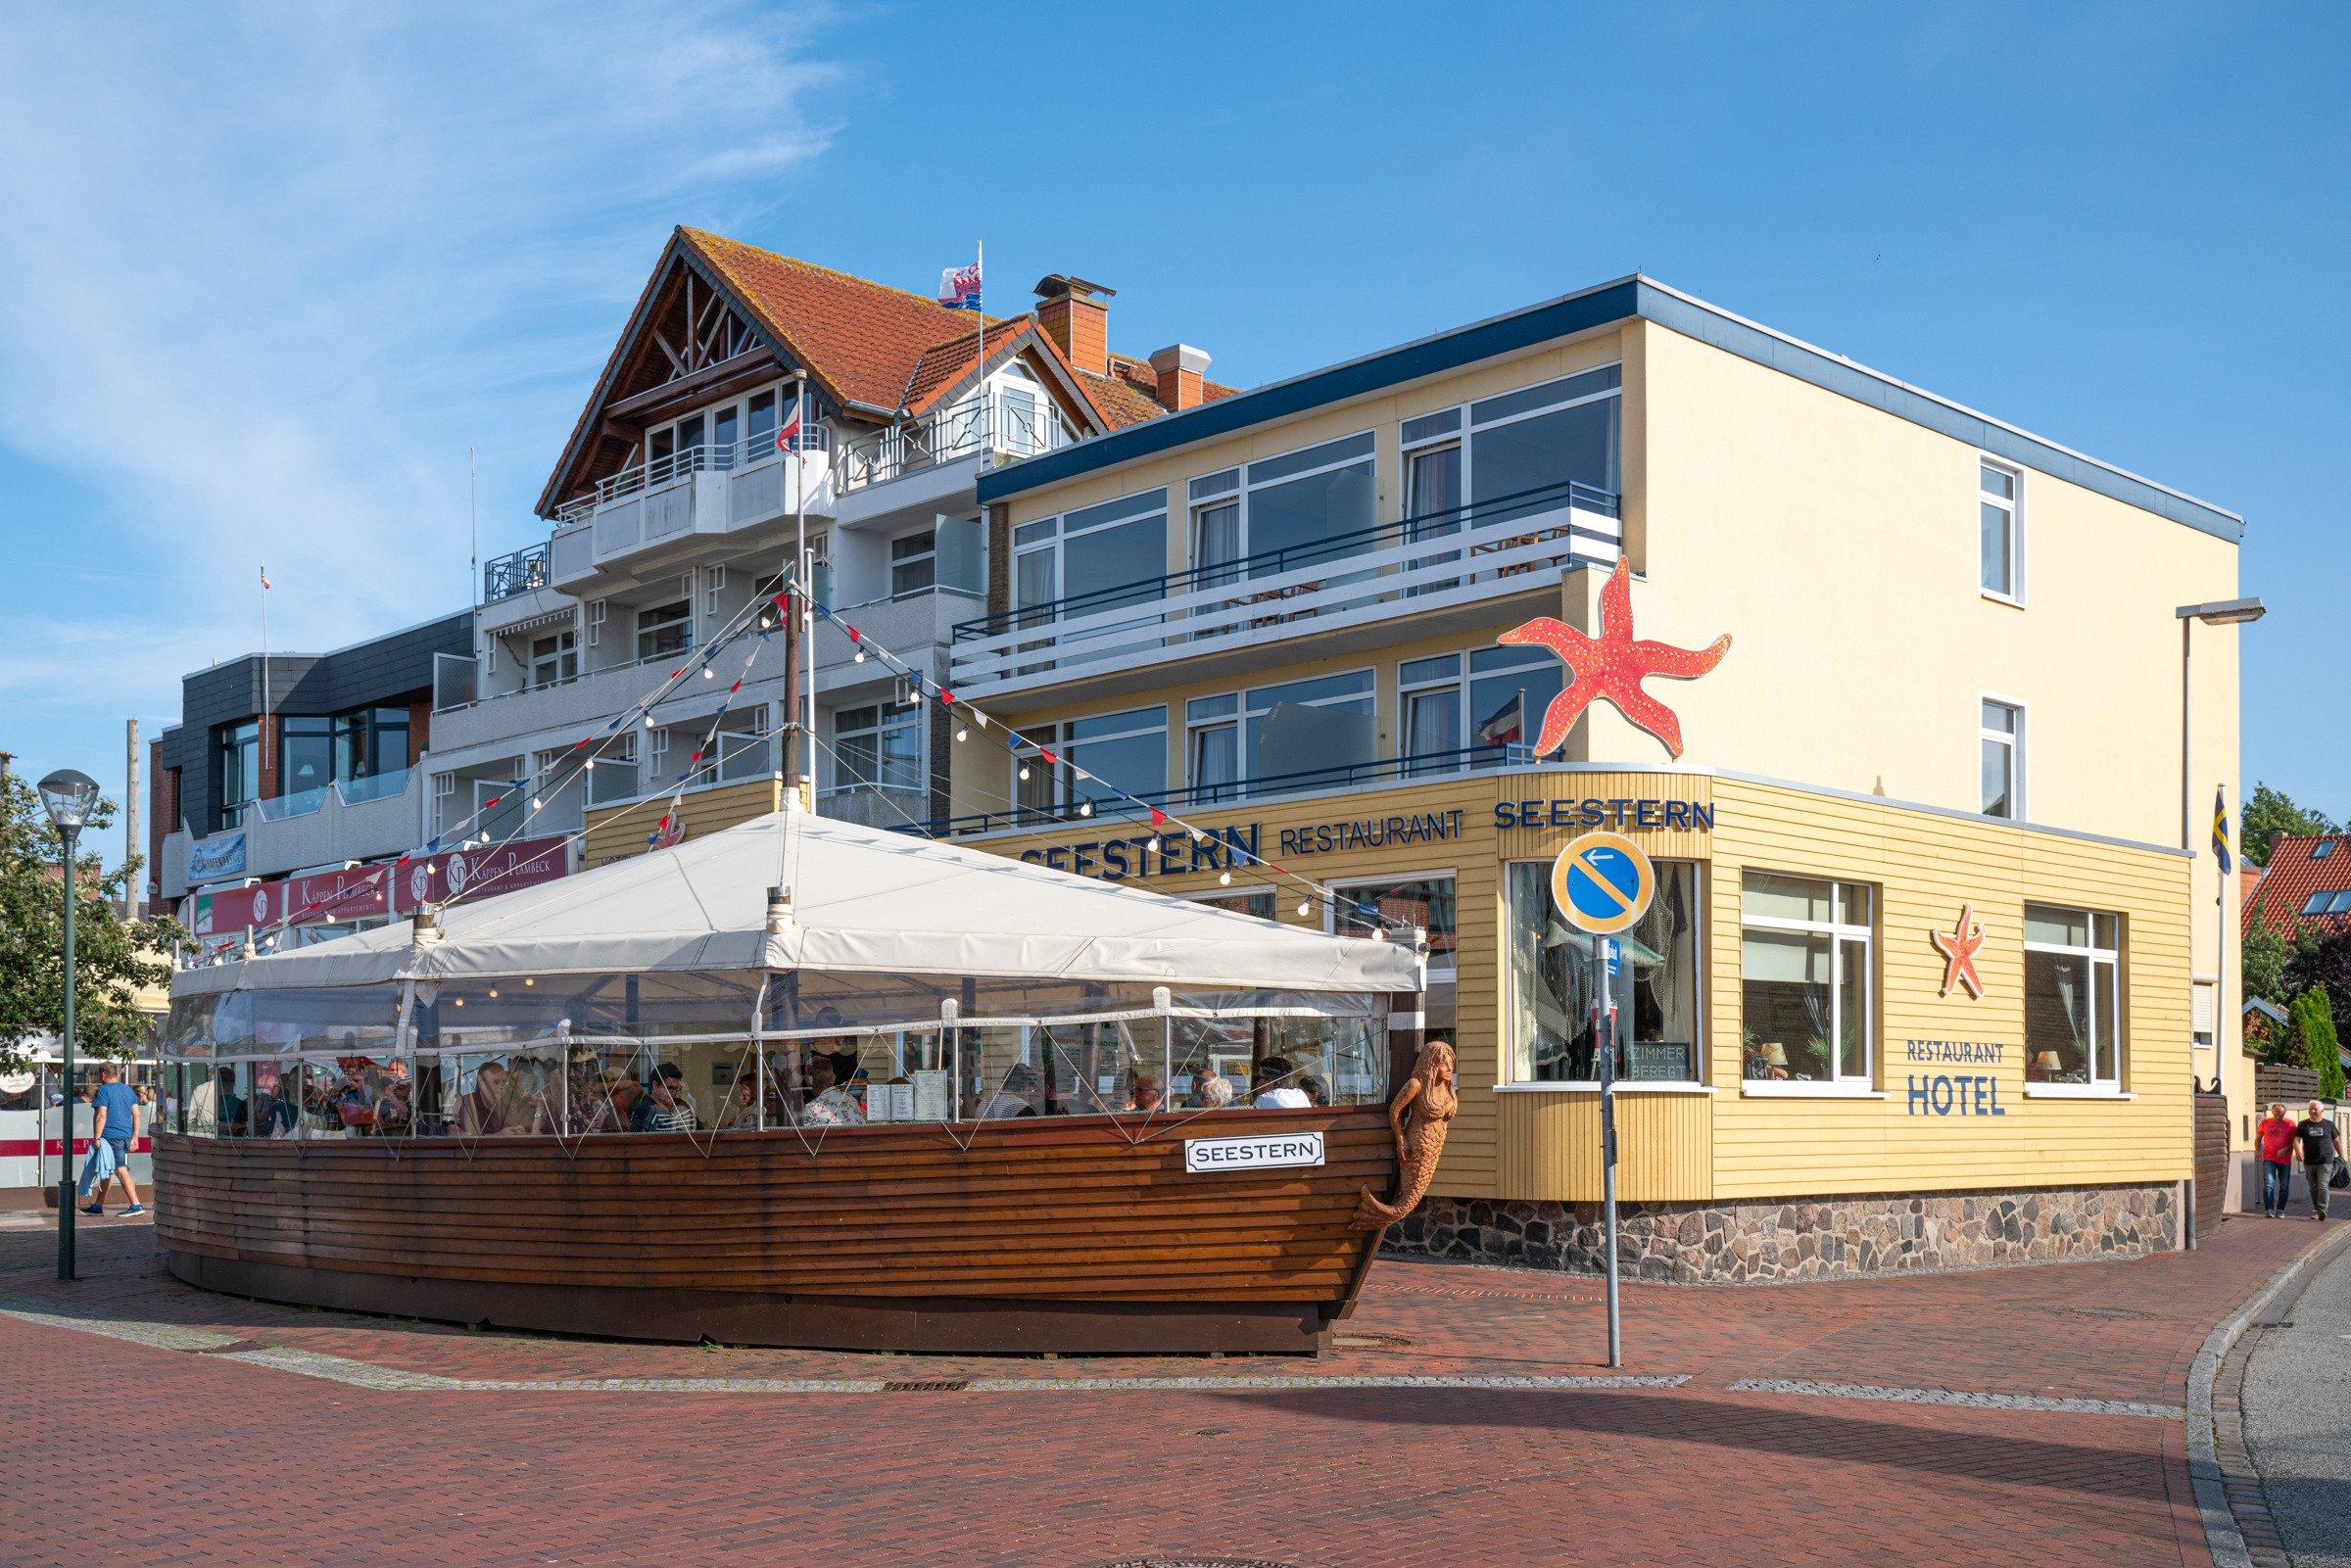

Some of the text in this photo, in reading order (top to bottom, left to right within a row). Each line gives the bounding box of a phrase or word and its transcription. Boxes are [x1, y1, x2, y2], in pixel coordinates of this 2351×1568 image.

[1494, 798, 1714, 830] SEESTERN
[1280, 809, 1464, 857] RESTAURANT
[471, 852, 551, 881] KÄPPEN PLAMBECK
[302, 880, 333, 905] KÄPPEN
[1632, 1047, 1685, 1061] ZIMMER
[1907, 1040, 2003, 1063] RESTAURANT
[1907, 1074, 2005, 1116] HOTEL
[1196, 1142, 1313, 1162] SEESTERN
